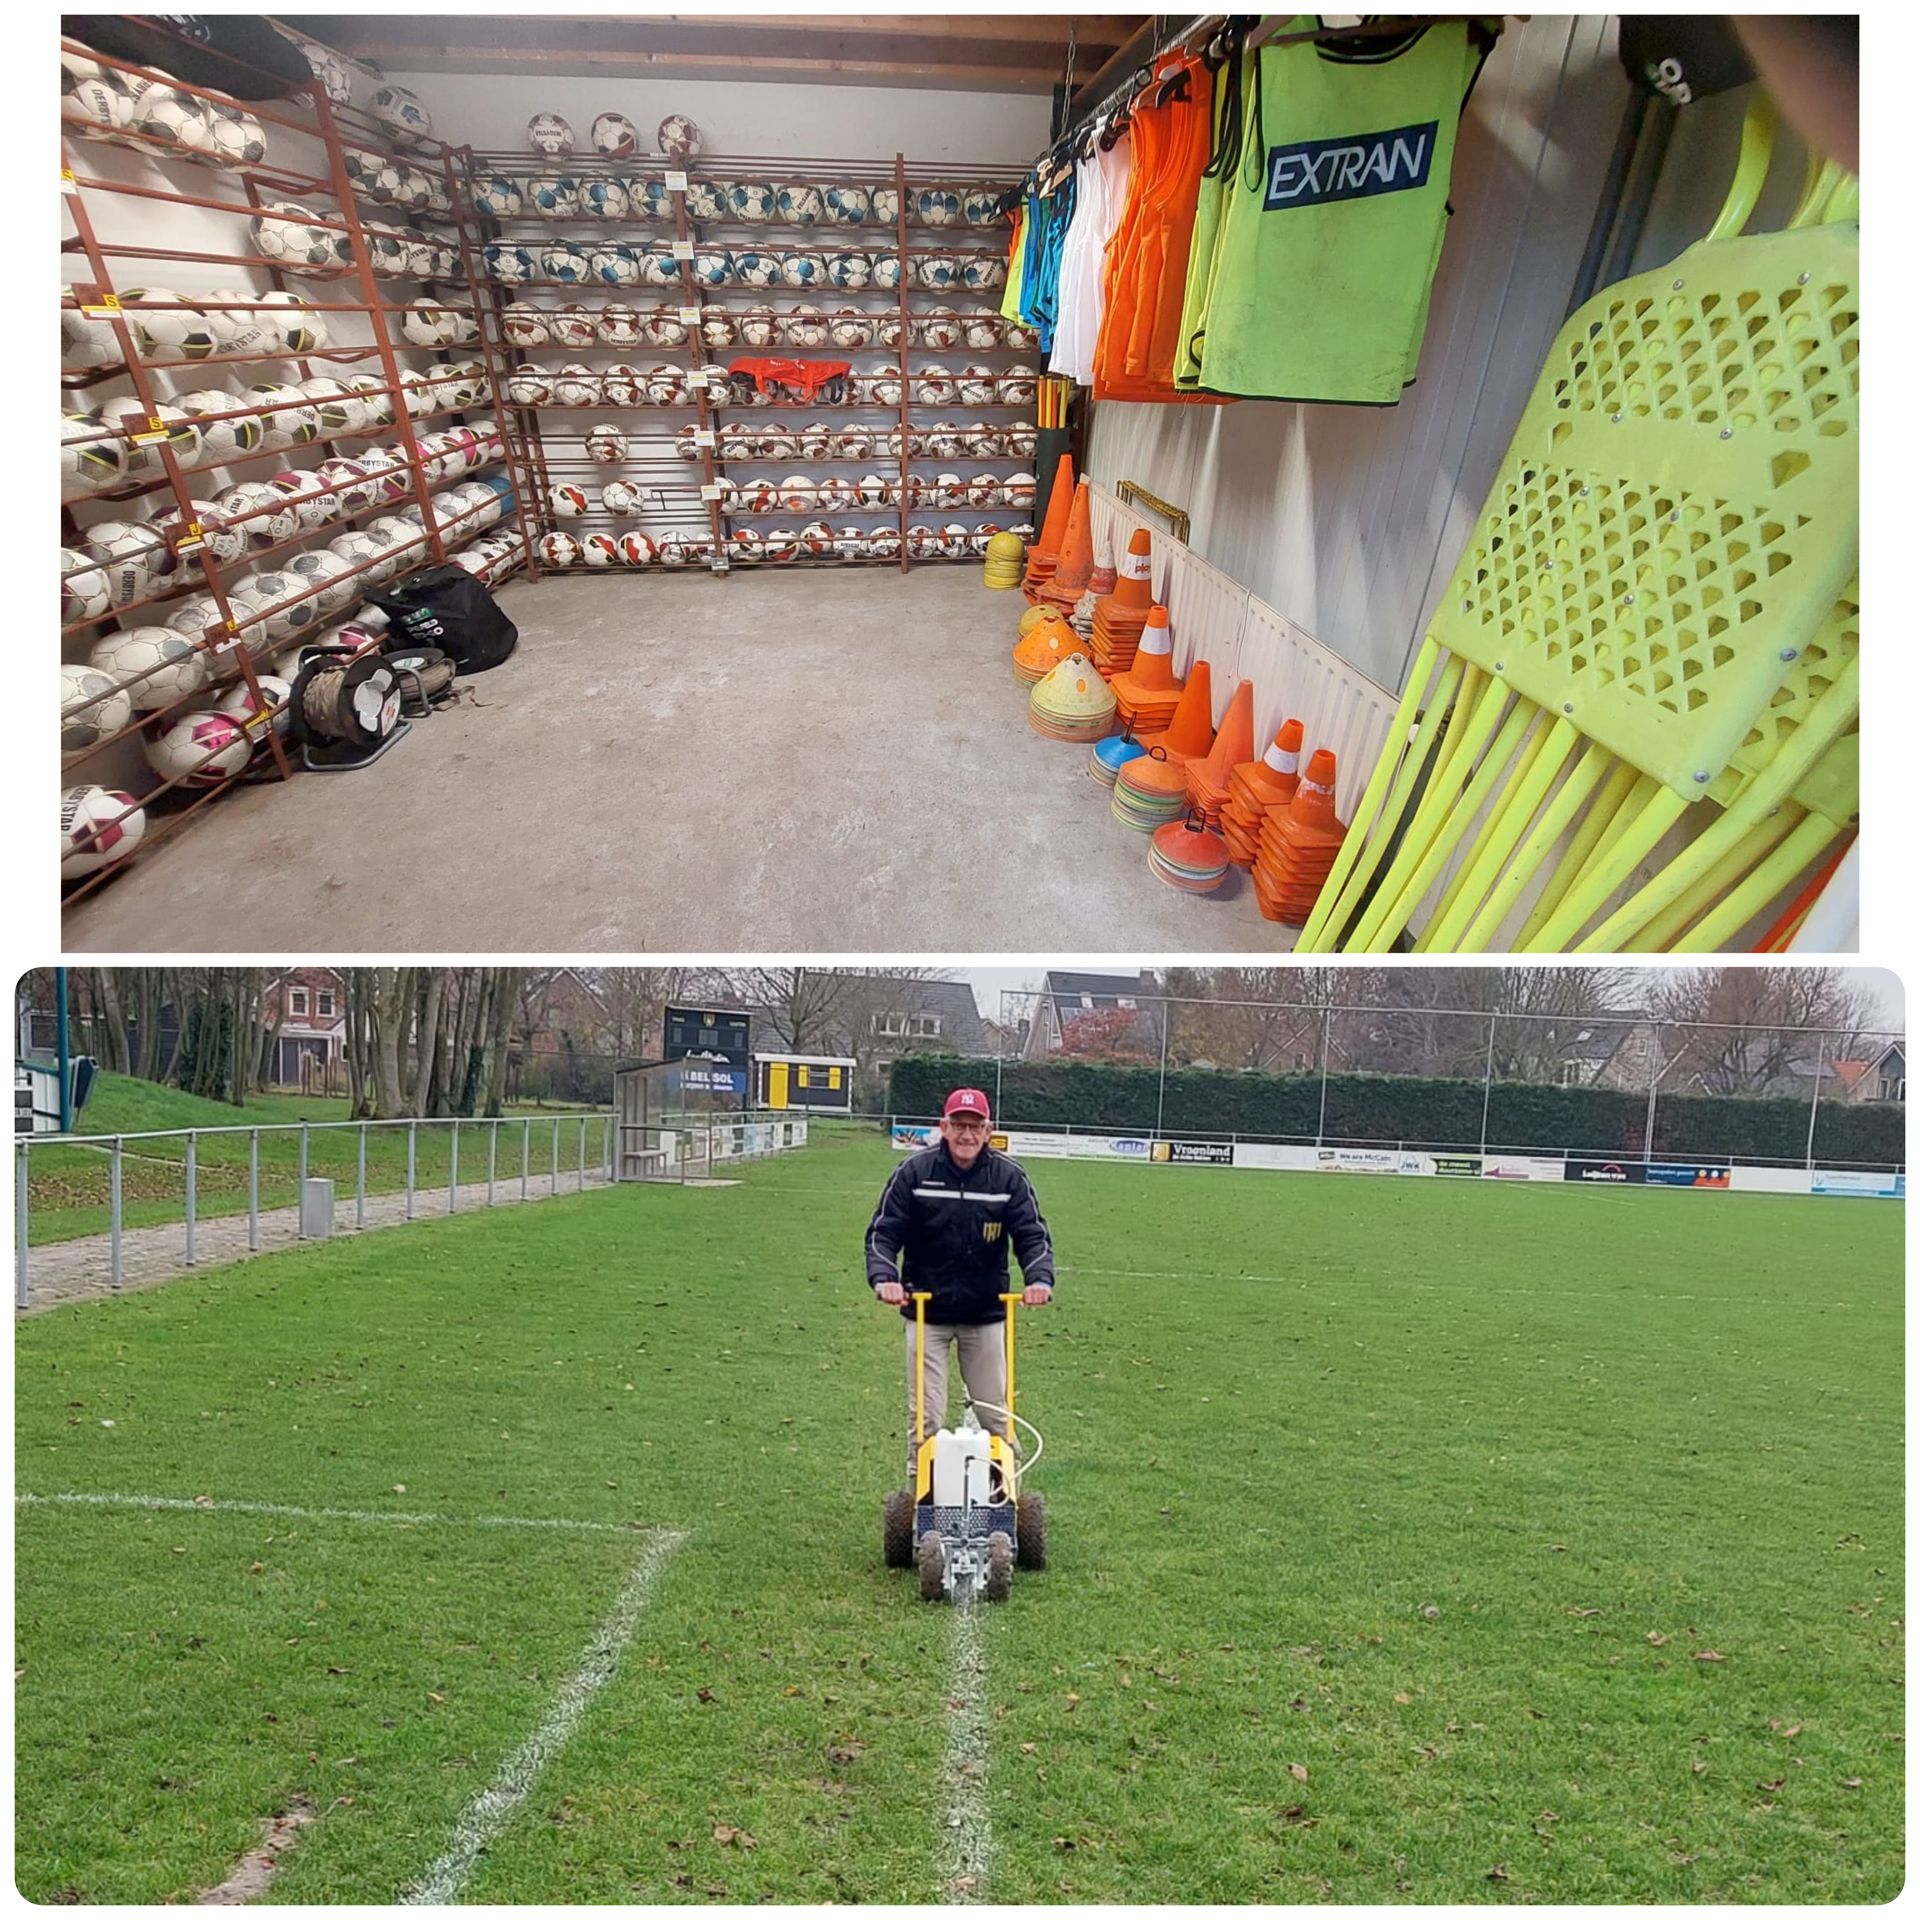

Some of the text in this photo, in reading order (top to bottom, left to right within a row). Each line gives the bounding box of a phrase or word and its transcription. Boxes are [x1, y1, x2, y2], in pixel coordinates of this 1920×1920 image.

[1268, 134, 1427, 201] EXTRAN
[106, 296, 118, 307] S
[152, 416, 162, 429] S
